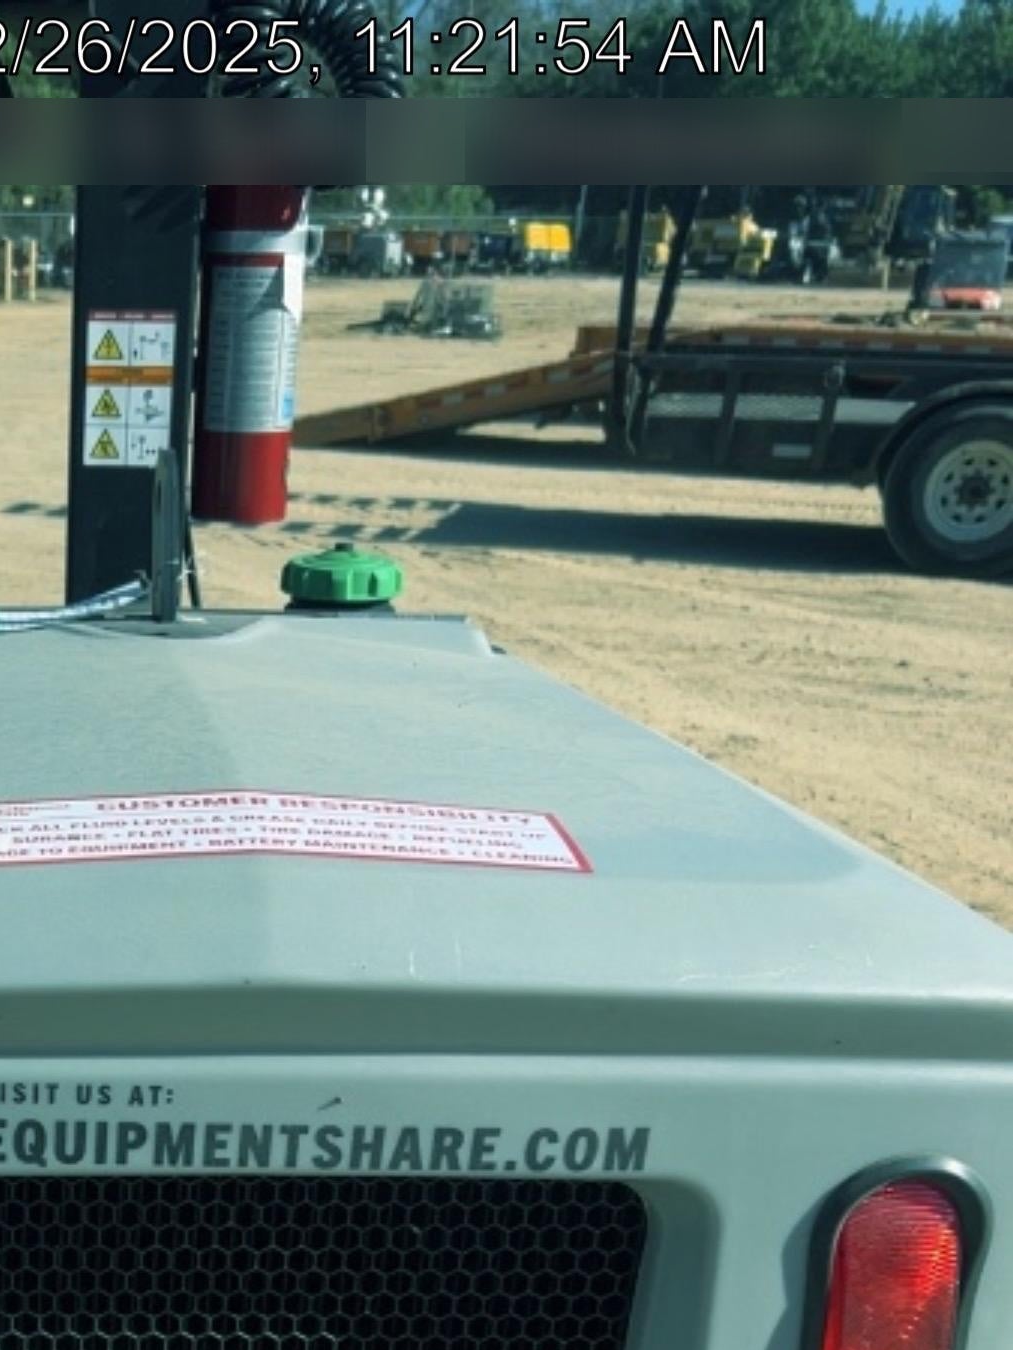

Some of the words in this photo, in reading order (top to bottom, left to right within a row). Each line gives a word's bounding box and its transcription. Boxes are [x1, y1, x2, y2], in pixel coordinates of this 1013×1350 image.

[96, 797, 268, 811] CUSTOMER
[76, 1084, 113, 1106] US
[128, 1085, 175, 1106] AT:
